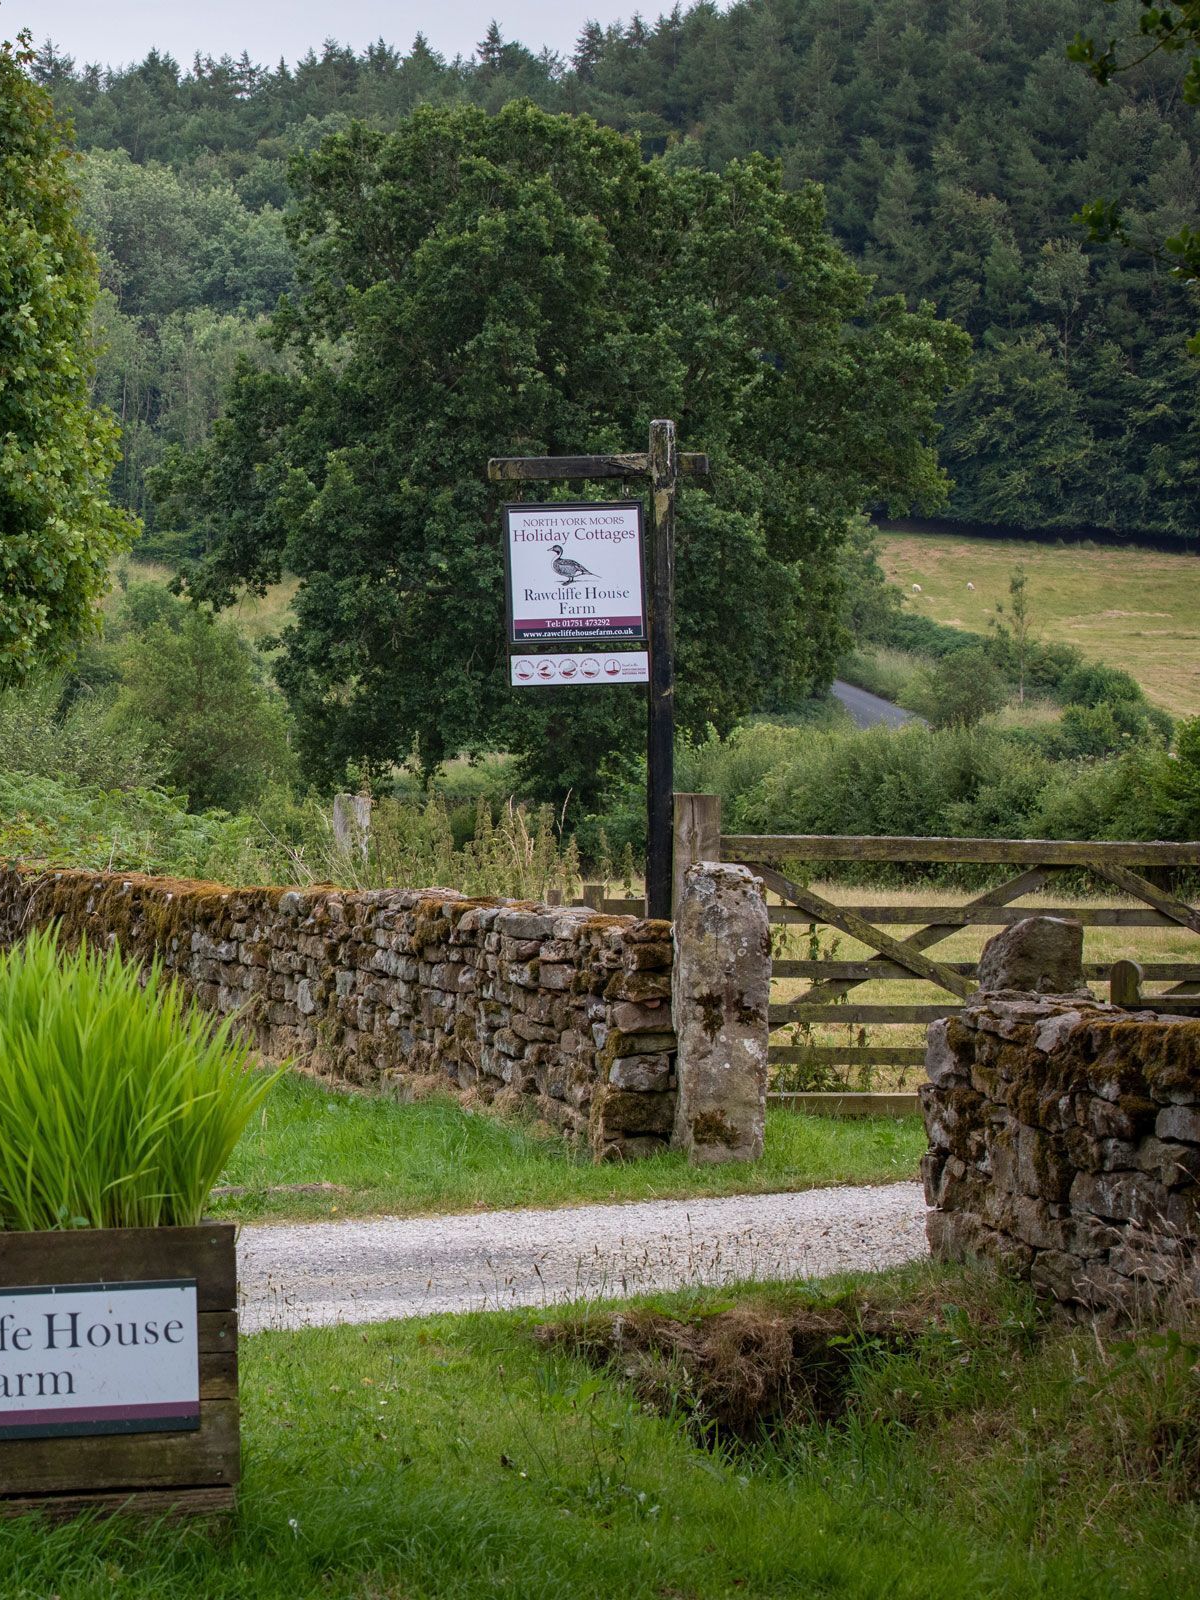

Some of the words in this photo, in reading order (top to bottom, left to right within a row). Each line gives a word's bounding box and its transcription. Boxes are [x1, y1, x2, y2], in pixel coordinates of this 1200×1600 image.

[523, 518, 558, 527] NORTH
[560, 517, 588, 526] YORK
[589, 516, 625, 525] MOORS
[513, 529, 570, 545] Holiday
[574, 528, 636, 543] Cottages
[524, 587, 582, 601] Rawcliffe
[585, 587, 630, 599] House
[559, 602, 596, 615] Farm
[545, 620, 561, 628] Tel:
[562, 619, 583, 627] 01751
[585, 618, 610, 627] 473292
[523, 628, 634, 638] www.rawcliffehousefarm.co.uk
[43, 1311, 185, 1351] House
